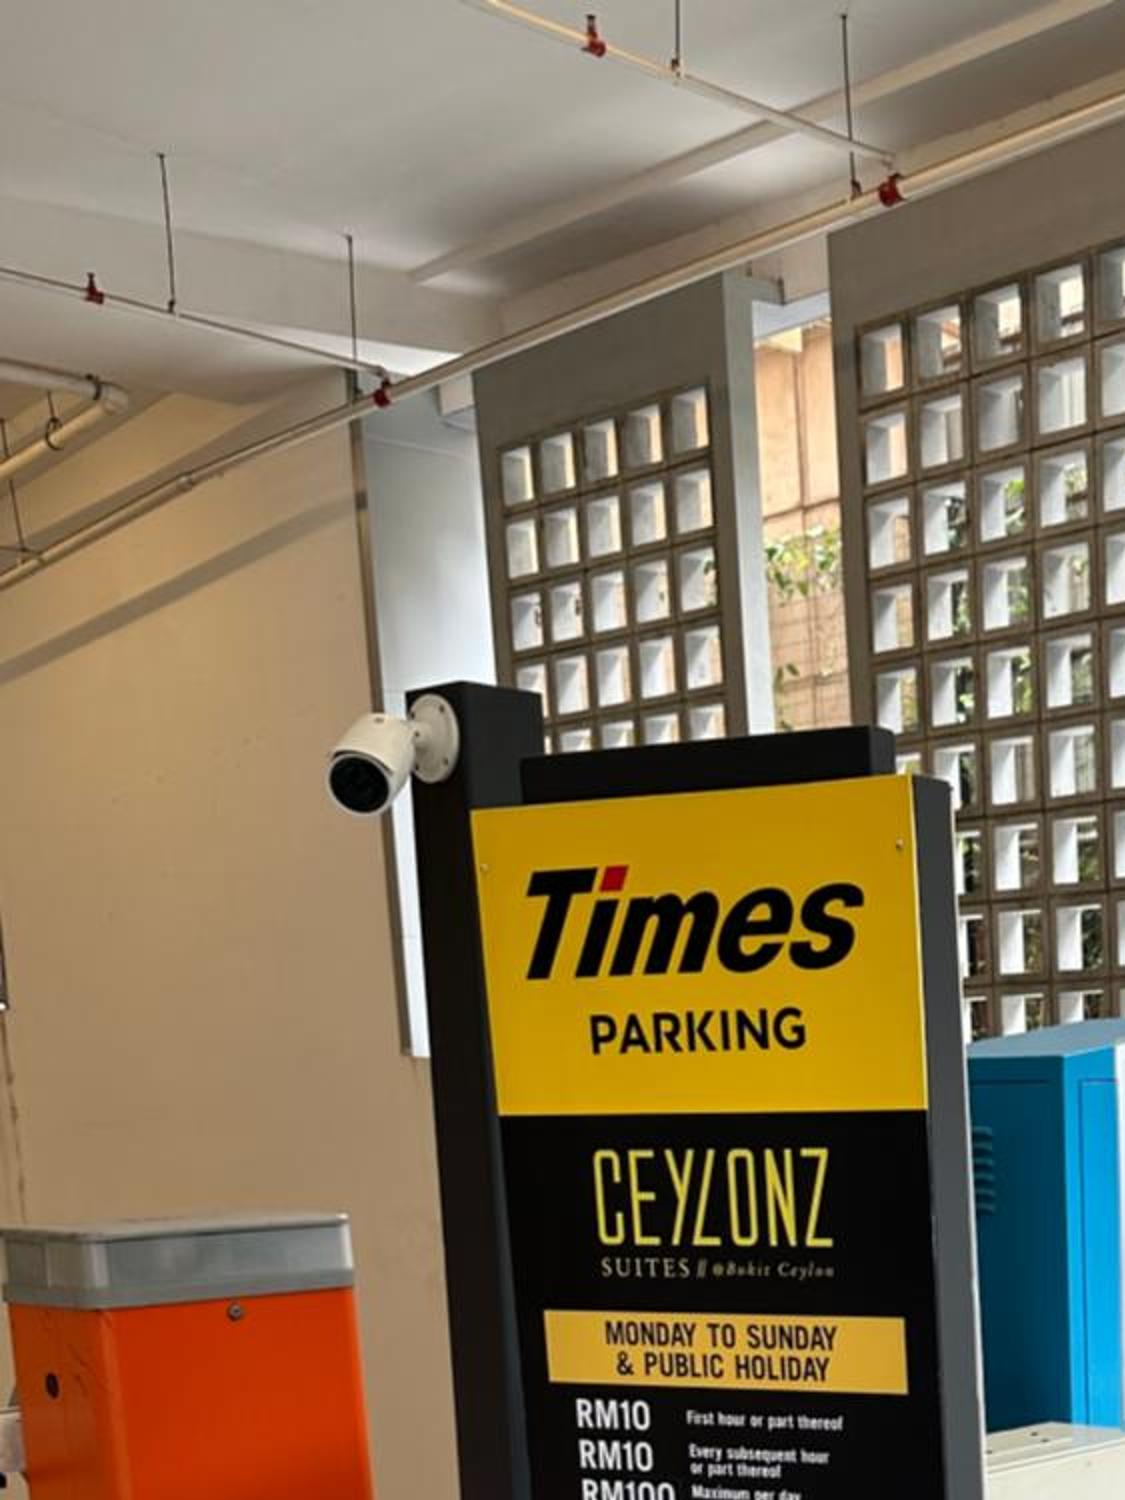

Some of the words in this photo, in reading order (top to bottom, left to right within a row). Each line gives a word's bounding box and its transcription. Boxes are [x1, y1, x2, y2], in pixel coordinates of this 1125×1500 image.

[526, 865, 864, 980] Times
[589, 1007, 807, 1055] PARKING
[593, 1147, 834, 1248] CEYLONZ
[601, 1257, 691, 1278] SUITES
[777, 1261, 835, 1281] Ceylon
[605, 1320, 696, 1348] MONDAY
[708, 1323, 736, 1348] TO
[746, 1324, 838, 1351] SUNDAY
[616, 1352, 634, 1375] &
[644, 1352, 724, 1378] PUBLIC
[736, 1356, 830, 1382] HOLIDAY
[576, 1398, 650, 1431] RM10
[686, 1410, 714, 1425] First
[717, 1412, 745, 1427] hour
[750, 1415, 763, 1428] or
[768, 1415, 794, 1432] part
[798, 1415, 843, 1430] thereof
[579, 1438, 653, 1472] RM10
[689, 1443, 722, 1462] Every
[726, 1445, 797, 1464] subsequent
[801, 1448, 829, 1463] hour
[690, 1462, 703, 1474] or
[708, 1463, 733, 1478] part
[737, 1462, 781, 1478] thereof
[691, 1484, 750, 1500] Maximum
